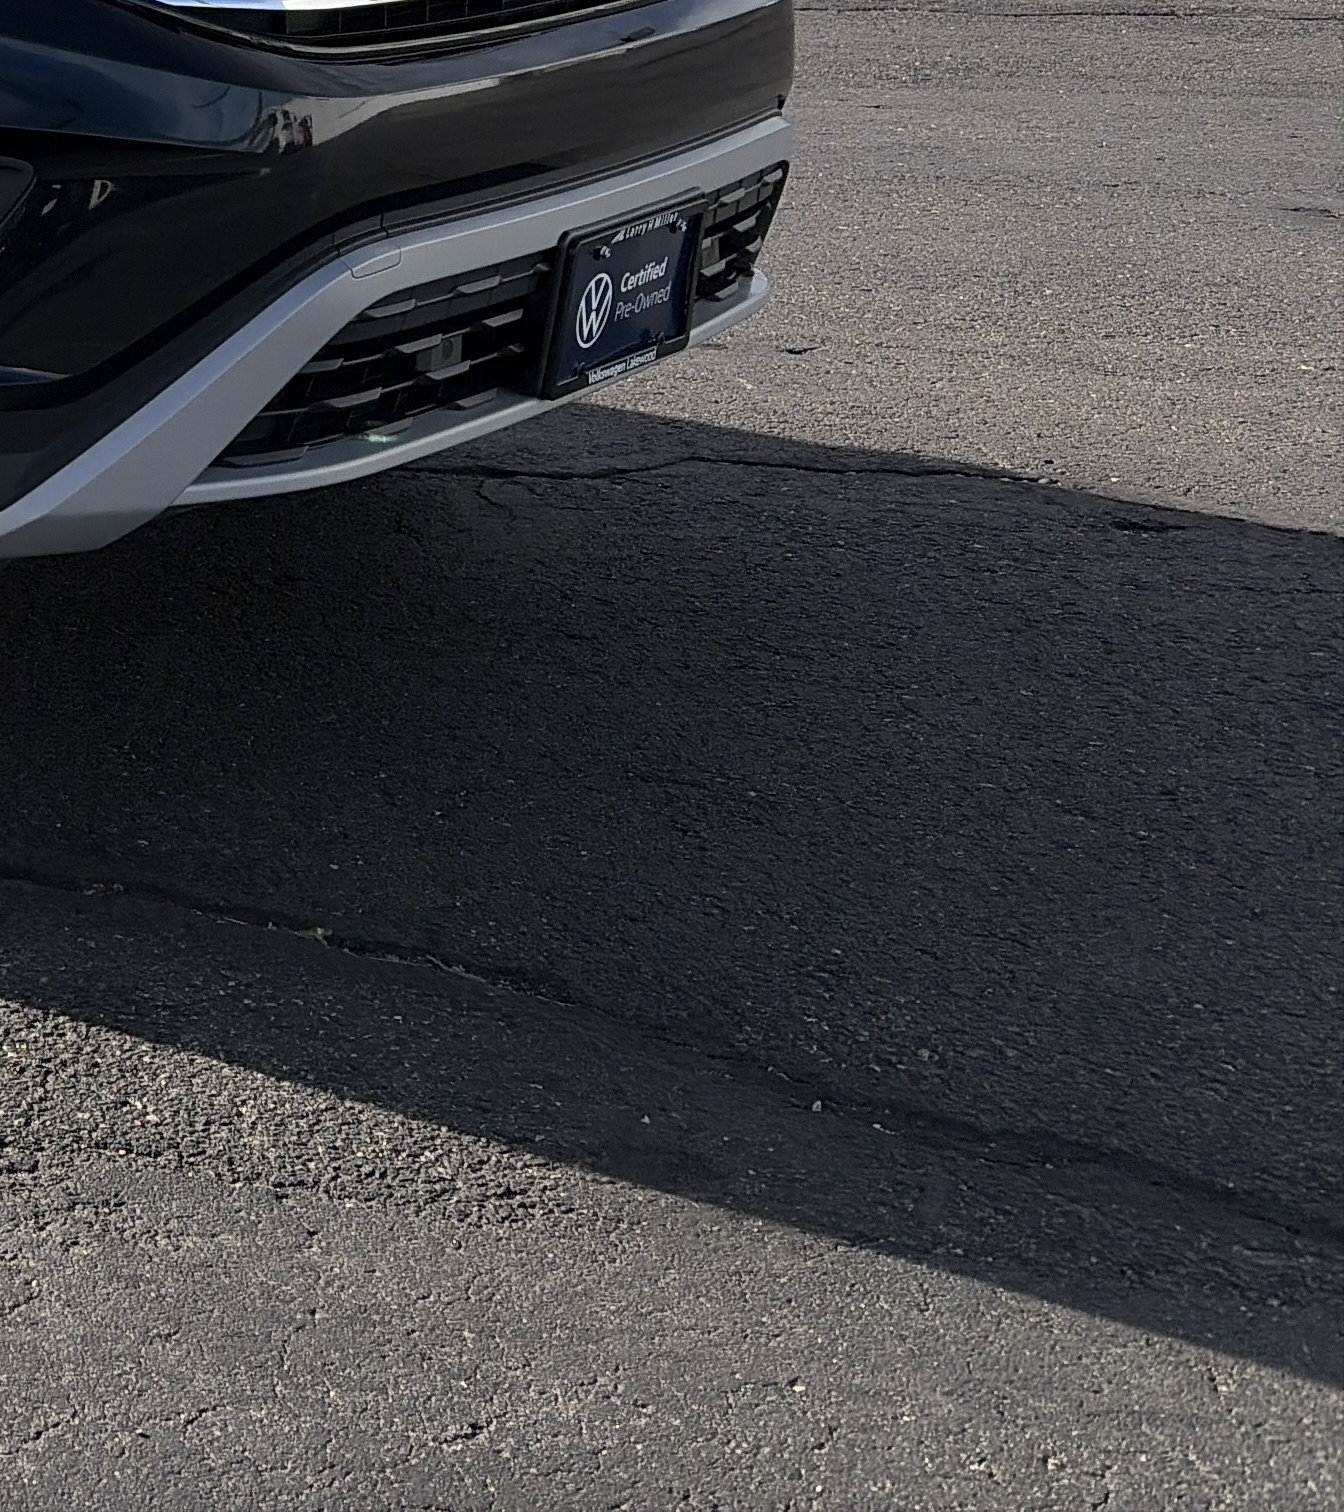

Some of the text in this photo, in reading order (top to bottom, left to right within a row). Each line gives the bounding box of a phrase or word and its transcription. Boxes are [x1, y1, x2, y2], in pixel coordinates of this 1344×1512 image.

[626, 223, 648, 239] Larry
[620, 256, 668, 293] Certified
[614, 281, 672, 322] Pre-Owned
